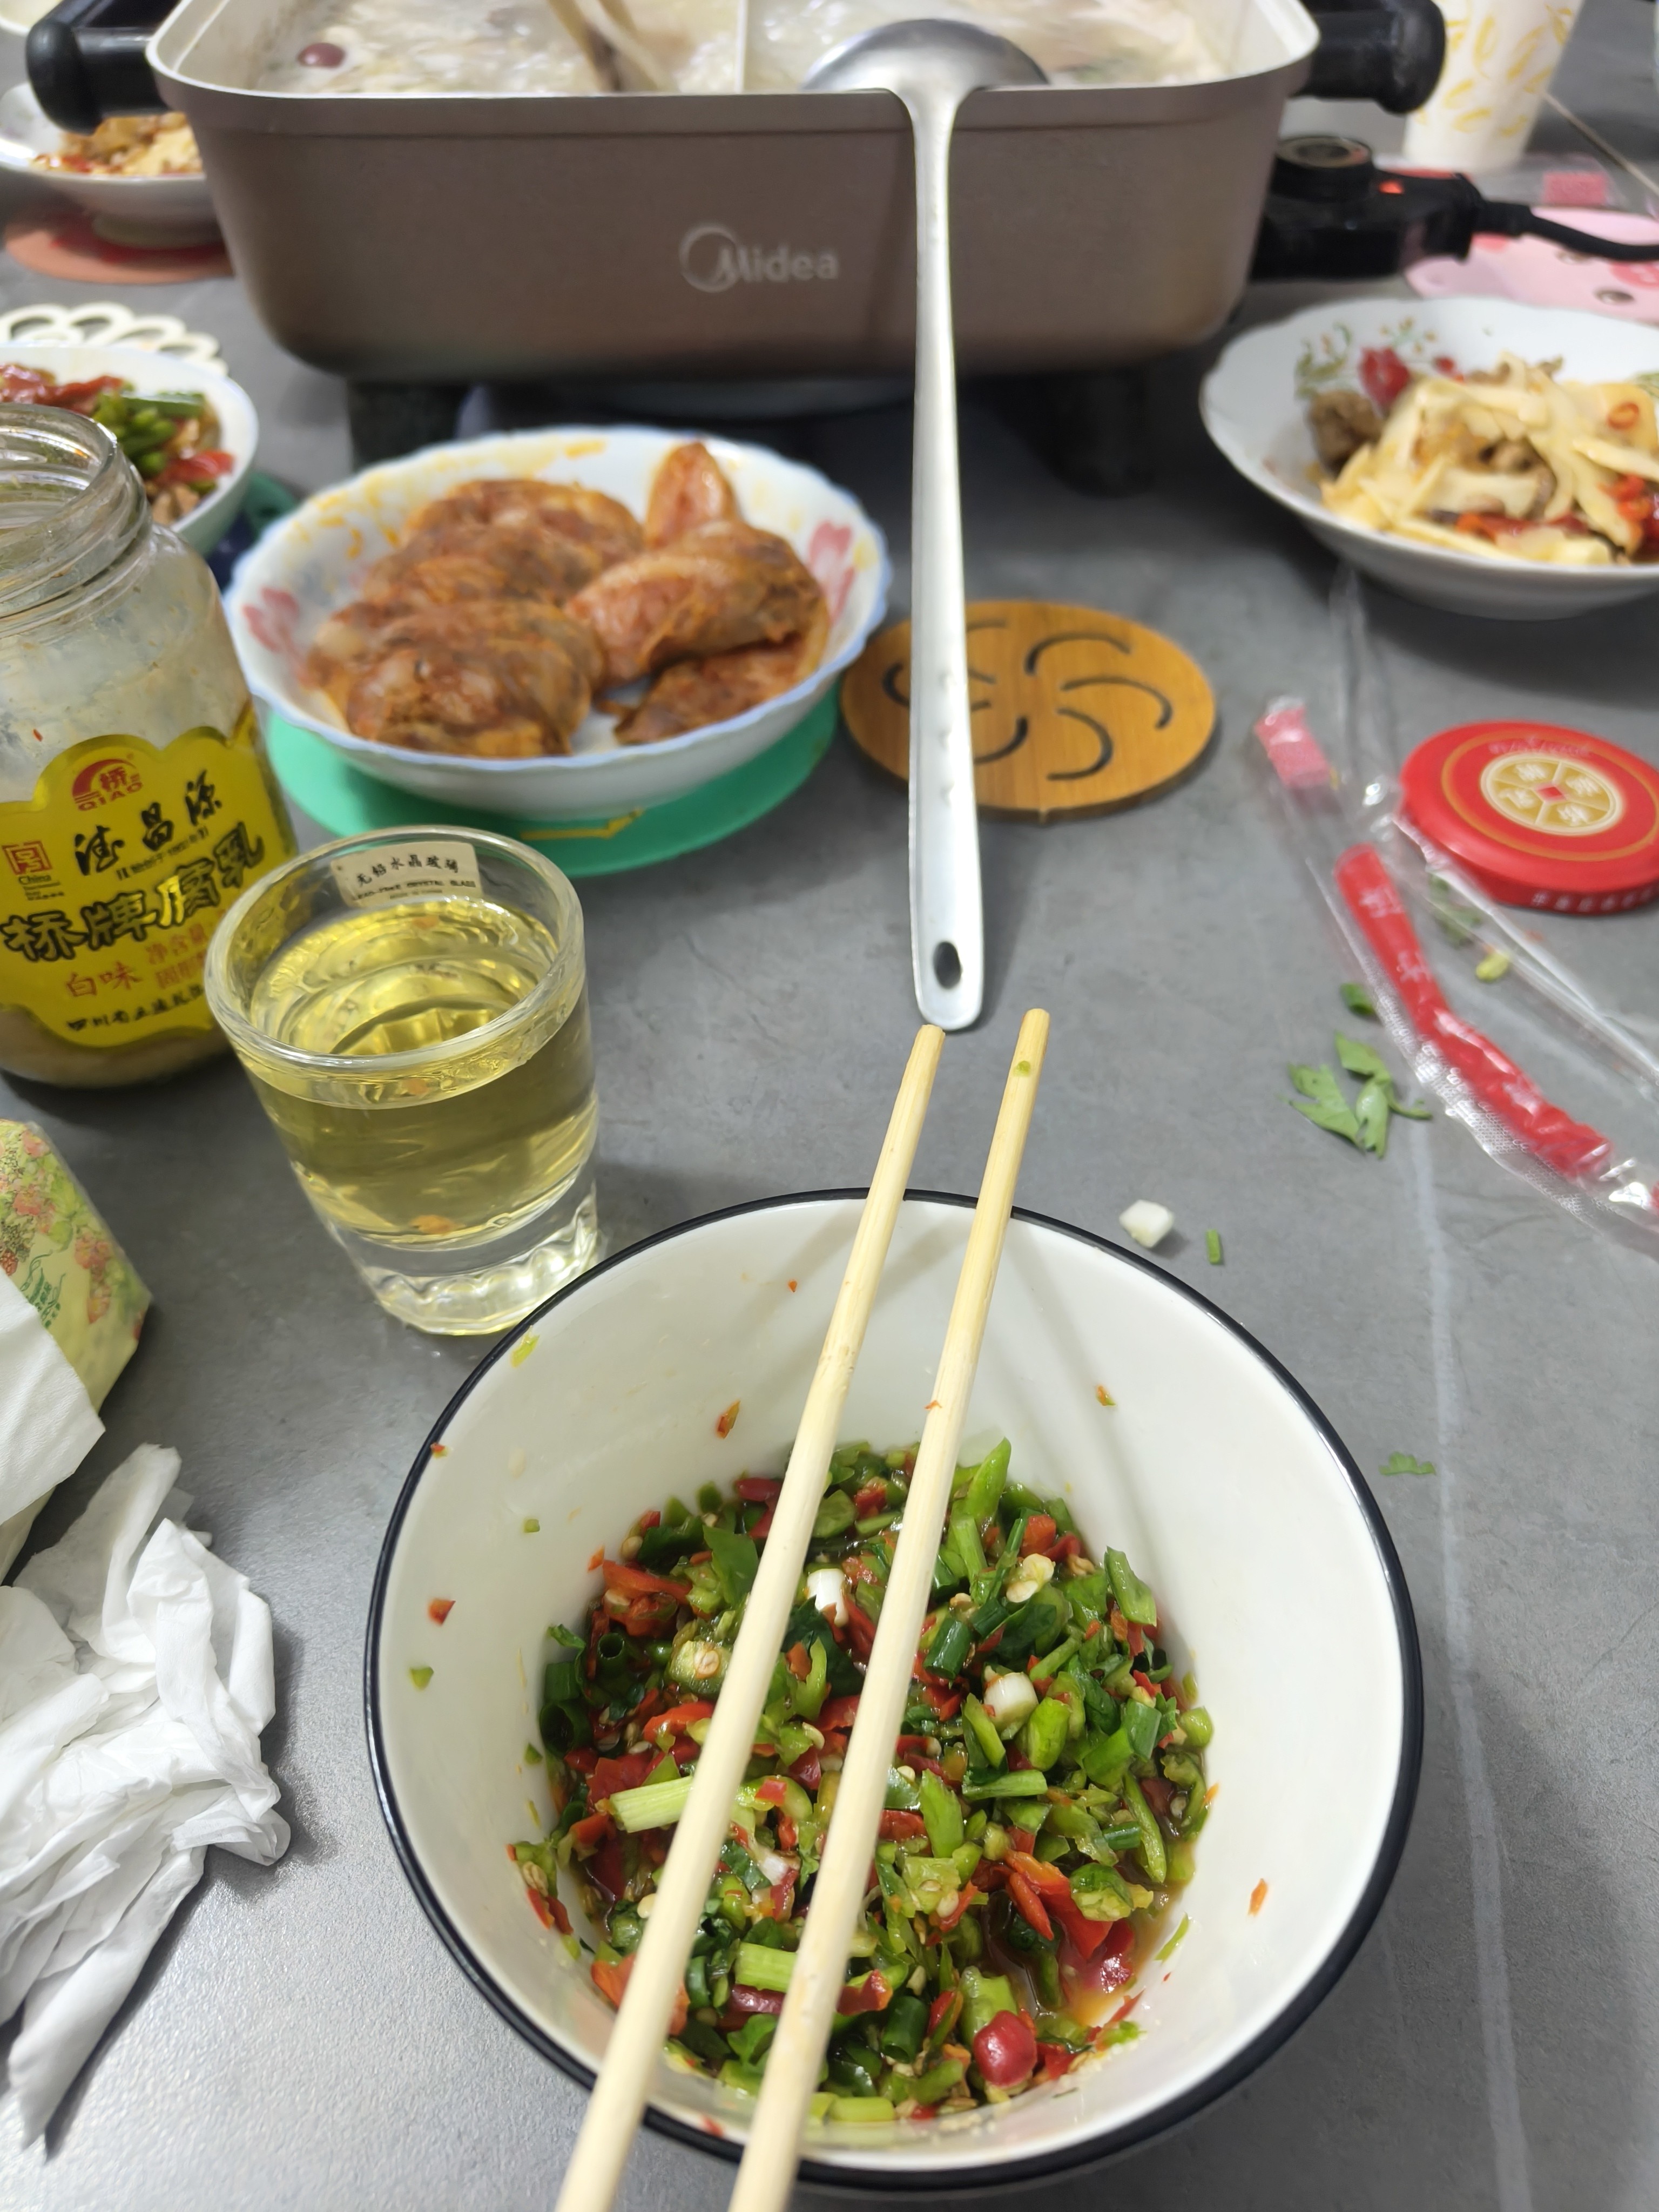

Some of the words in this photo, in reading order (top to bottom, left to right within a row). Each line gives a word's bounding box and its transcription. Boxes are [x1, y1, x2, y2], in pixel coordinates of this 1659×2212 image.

[679, 222, 840, 293] Midea
[78, 781, 143, 811] QIAO
[0, 821, 264, 962] 桥牌腐乳
[66, 961, 143, 997] 白味
